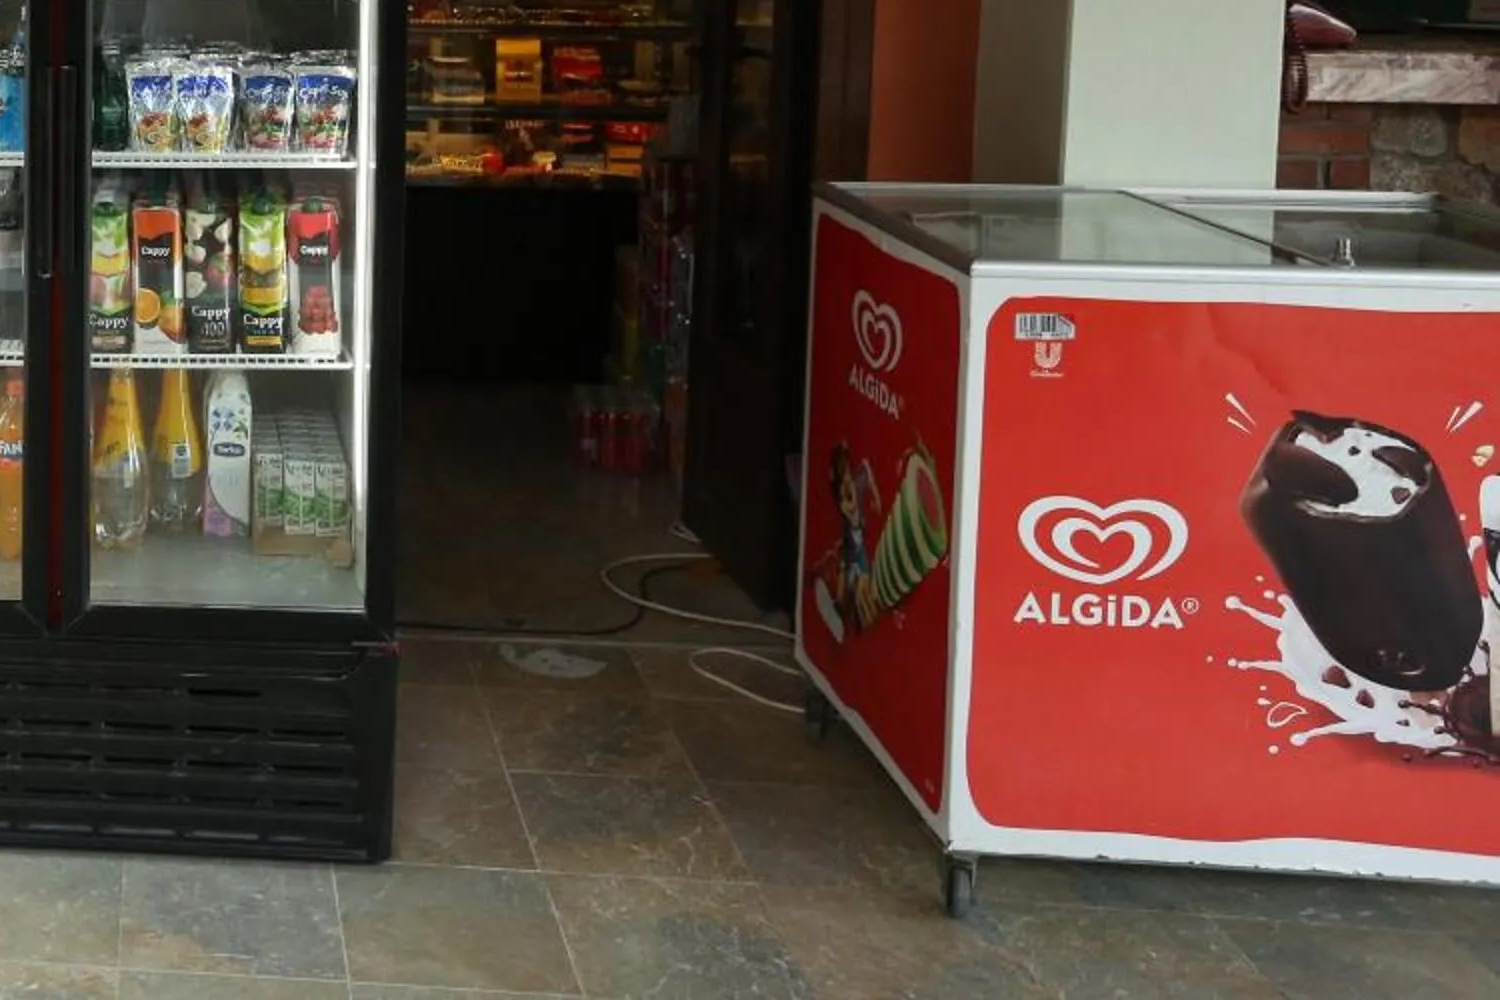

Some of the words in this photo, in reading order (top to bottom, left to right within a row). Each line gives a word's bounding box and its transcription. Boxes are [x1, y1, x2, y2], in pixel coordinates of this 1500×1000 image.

[140, 246, 171, 258] Cappy
[88, 313, 130, 329] Cappy
[191, 305, 231, 321] Cappy
[243, 313, 286, 330] Cappy
